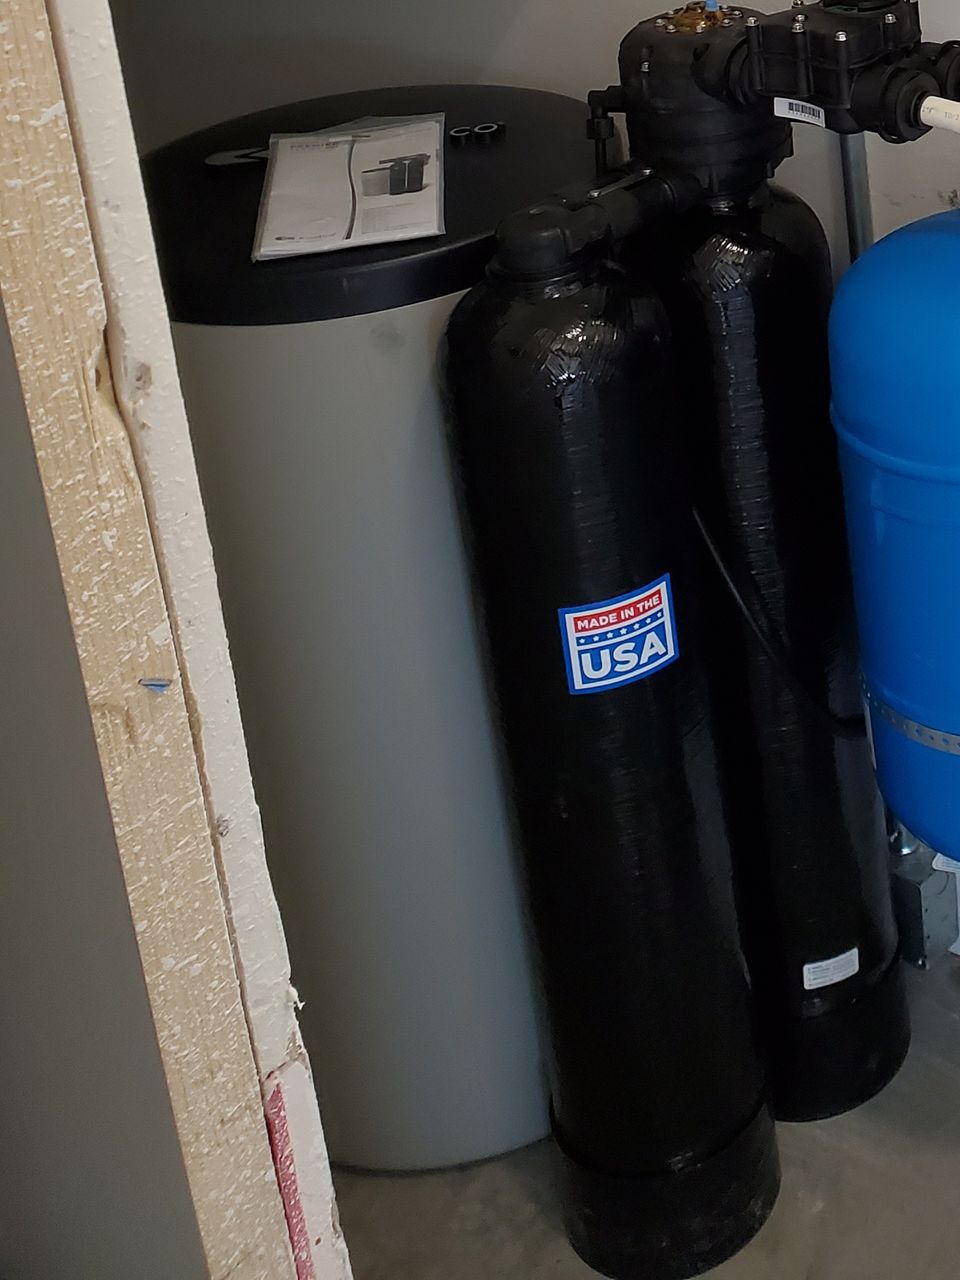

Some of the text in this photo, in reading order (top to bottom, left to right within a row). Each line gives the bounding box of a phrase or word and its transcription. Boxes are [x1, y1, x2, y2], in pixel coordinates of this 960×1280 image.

[577, 594, 660, 630] MADE IN THE
[581, 631, 667, 679] USA
